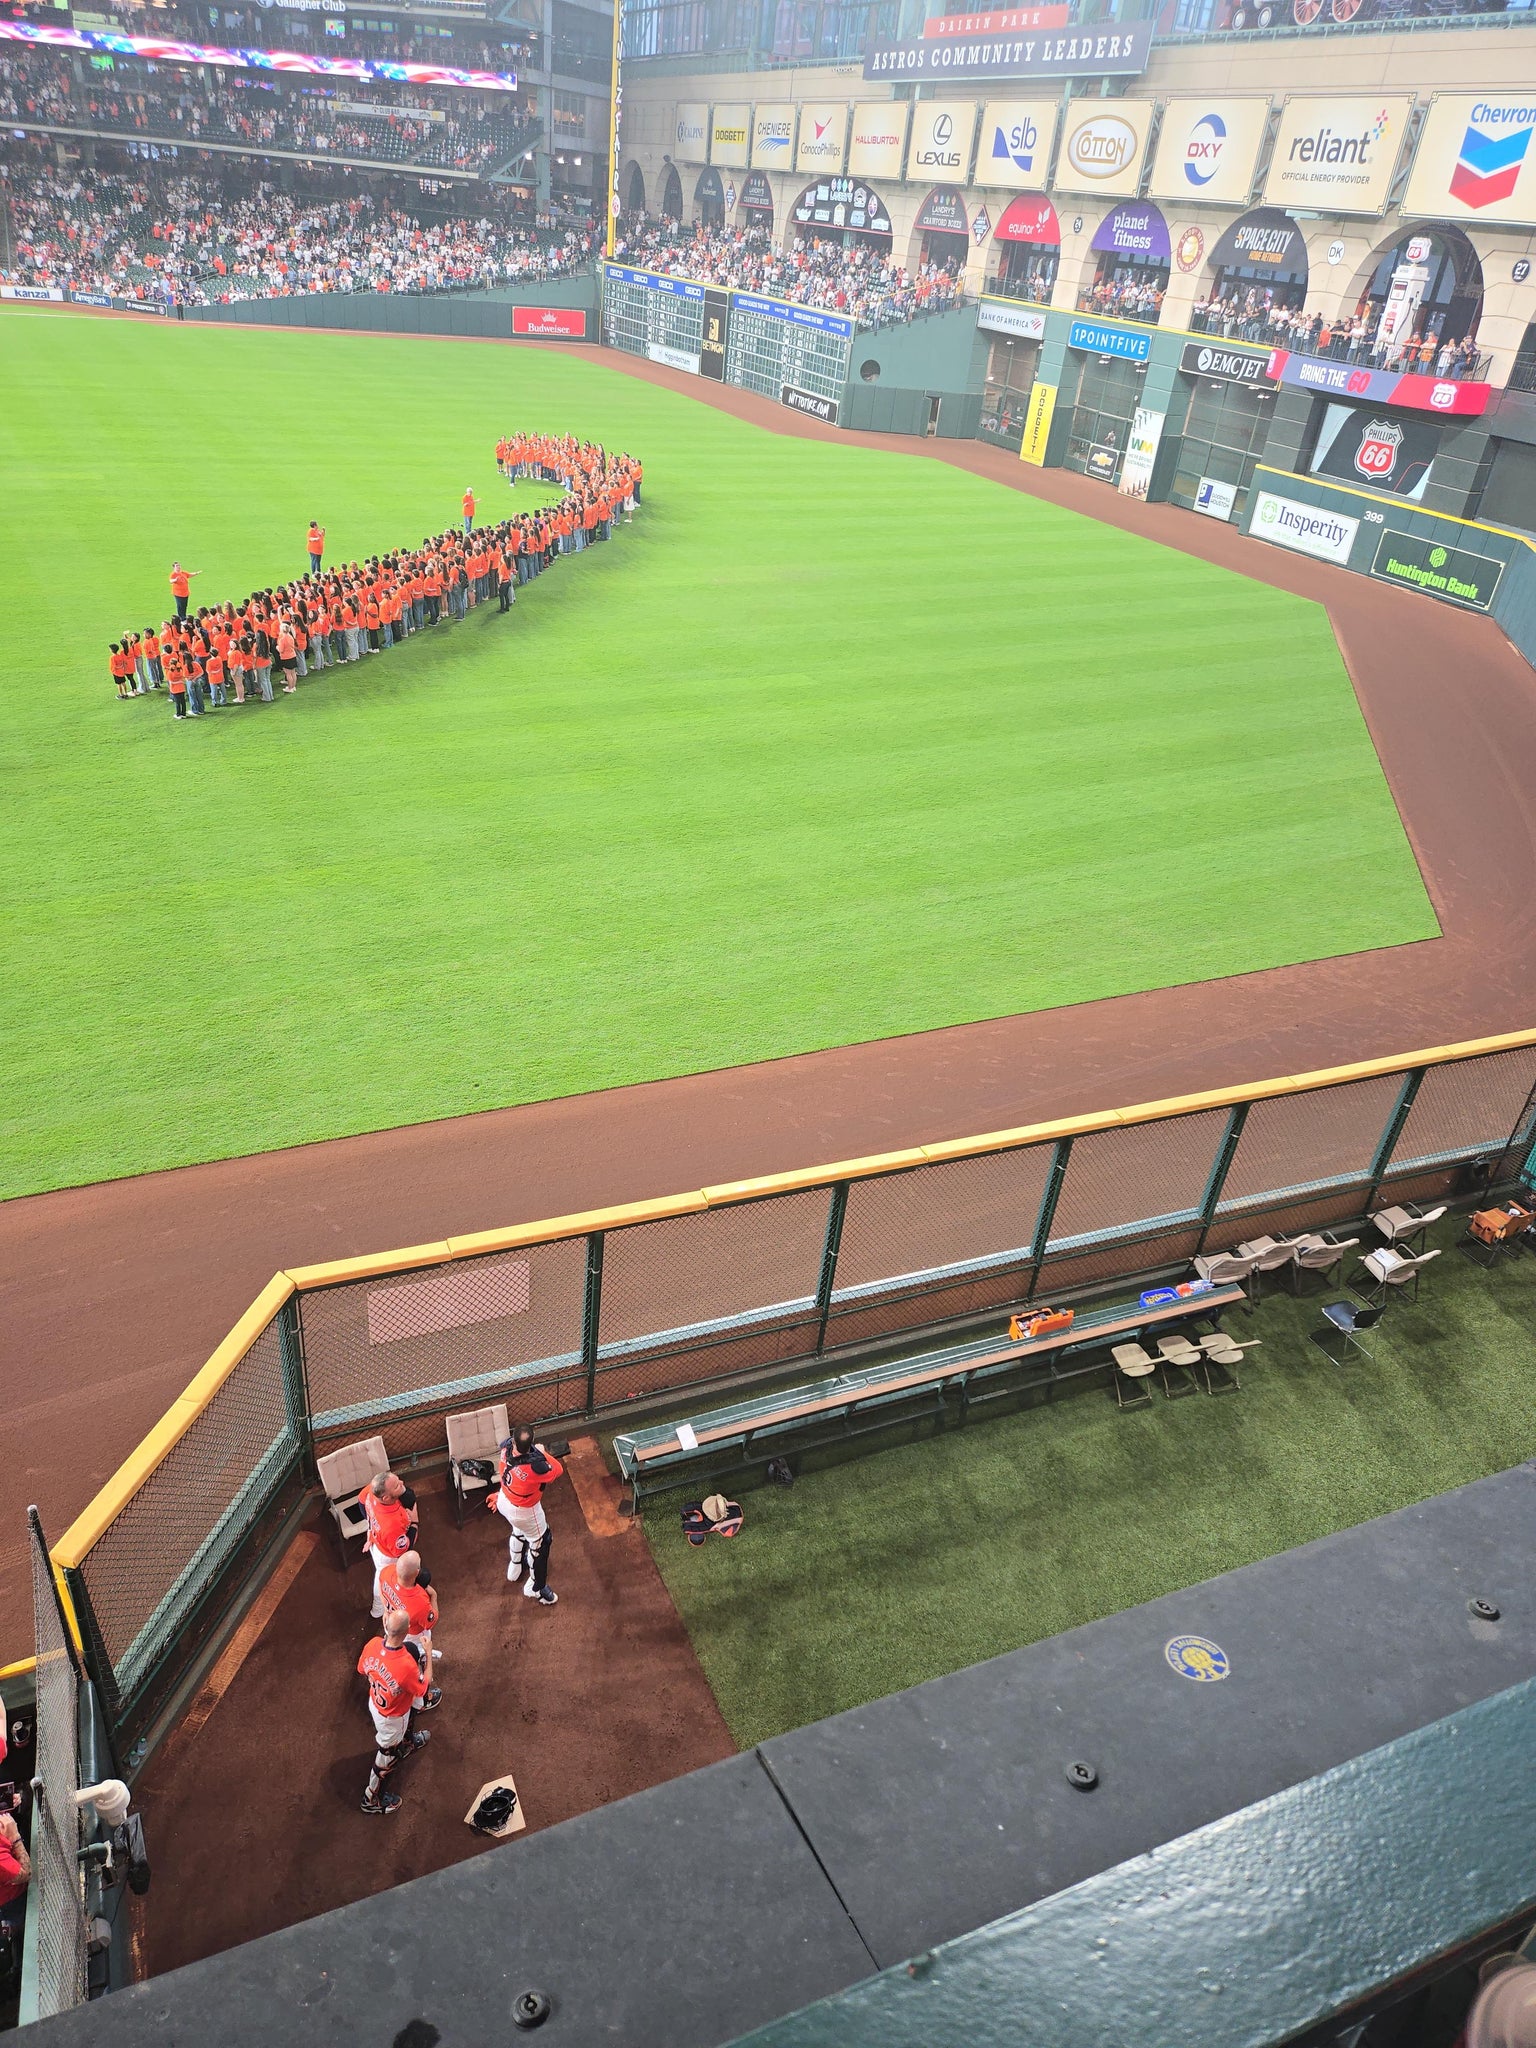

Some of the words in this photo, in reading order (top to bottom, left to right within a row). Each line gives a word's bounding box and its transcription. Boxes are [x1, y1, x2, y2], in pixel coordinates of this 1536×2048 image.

[322, 0, 346, 11] Club
[938, 17, 990, 32] DAIKIN
[1001, 12, 1041, 27] PARK
[872, 49, 925, 70] ASTROS
[931, 41, 1036, 67] COMMUNITY
[1042, 34, 1134, 61] LEADERS
[1470, 103, 1536, 124] Chevron
[715, 130, 745, 142] DOGGETT
[757, 122, 791, 136] CHENIERE
[1010, 116, 1037, 150] slb
[855, 135, 899, 145] HALLIBURTON
[1076, 130, 1127, 165] COTTON
[1289, 128, 1371, 165] reliant
[800, 142, 841, 159] ConocoPhillips
[1187, 142, 1223, 158] OXY
[916, 151, 961, 167] LEXUS
[1281, 171, 1309, 182] OFFICIAL
[1310, 173, 1335, 183] ENERGY
[1336, 174, 1371, 184] PROVIDER
[931, 205, 956, 215] LANDRY'S
[923, 216, 947, 226] CRAWFORD
[948, 220, 962, 229] BOXES
[1008, 222, 1035, 236] equinor
[1112, 212, 1149, 232] planet
[1113, 231, 1151, 250] fitness
[1234, 226, 1270, 251] SPACE
[1266, 230, 1294, 254] CITY
[1329, 246, 1343, 258] DK
[1409, 247, 1420, 257] 66
[610, 268, 624, 278] GEICO
[1514, 263, 1529, 275] 27
[633, 274, 648, 284] GEICO
[658, 280, 674, 290] GEICO
[684, 286, 701, 296] GEICO
[528, 322, 570, 334] Budweiser
[980, 312, 996, 322] BANK
[996, 315, 1004, 324] OF
[1004, 316, 1029, 328] AMERICA
[702, 340, 724, 354] BETMGM
[1075, 328, 1146, 355] 1POINTFIVE
[1211, 352, 1266, 380] EMCJET
[1300, 364, 1326, 384] BRING
[1328, 368, 1347, 388] THE
[1434, 393, 1451, 404] 66
[1031, 388, 1047, 454] DOGGETT
[1368, 428, 1398, 444] PHILLIPS
[1131, 437, 1153, 454] WM
[1362, 444, 1390, 468] 66
[1363, 510, 1384, 524] 399
[1278, 505, 1348, 547] Insperity
[1386, 558, 1448, 590] Huntington
[1446, 577, 1479, 600] Bank
